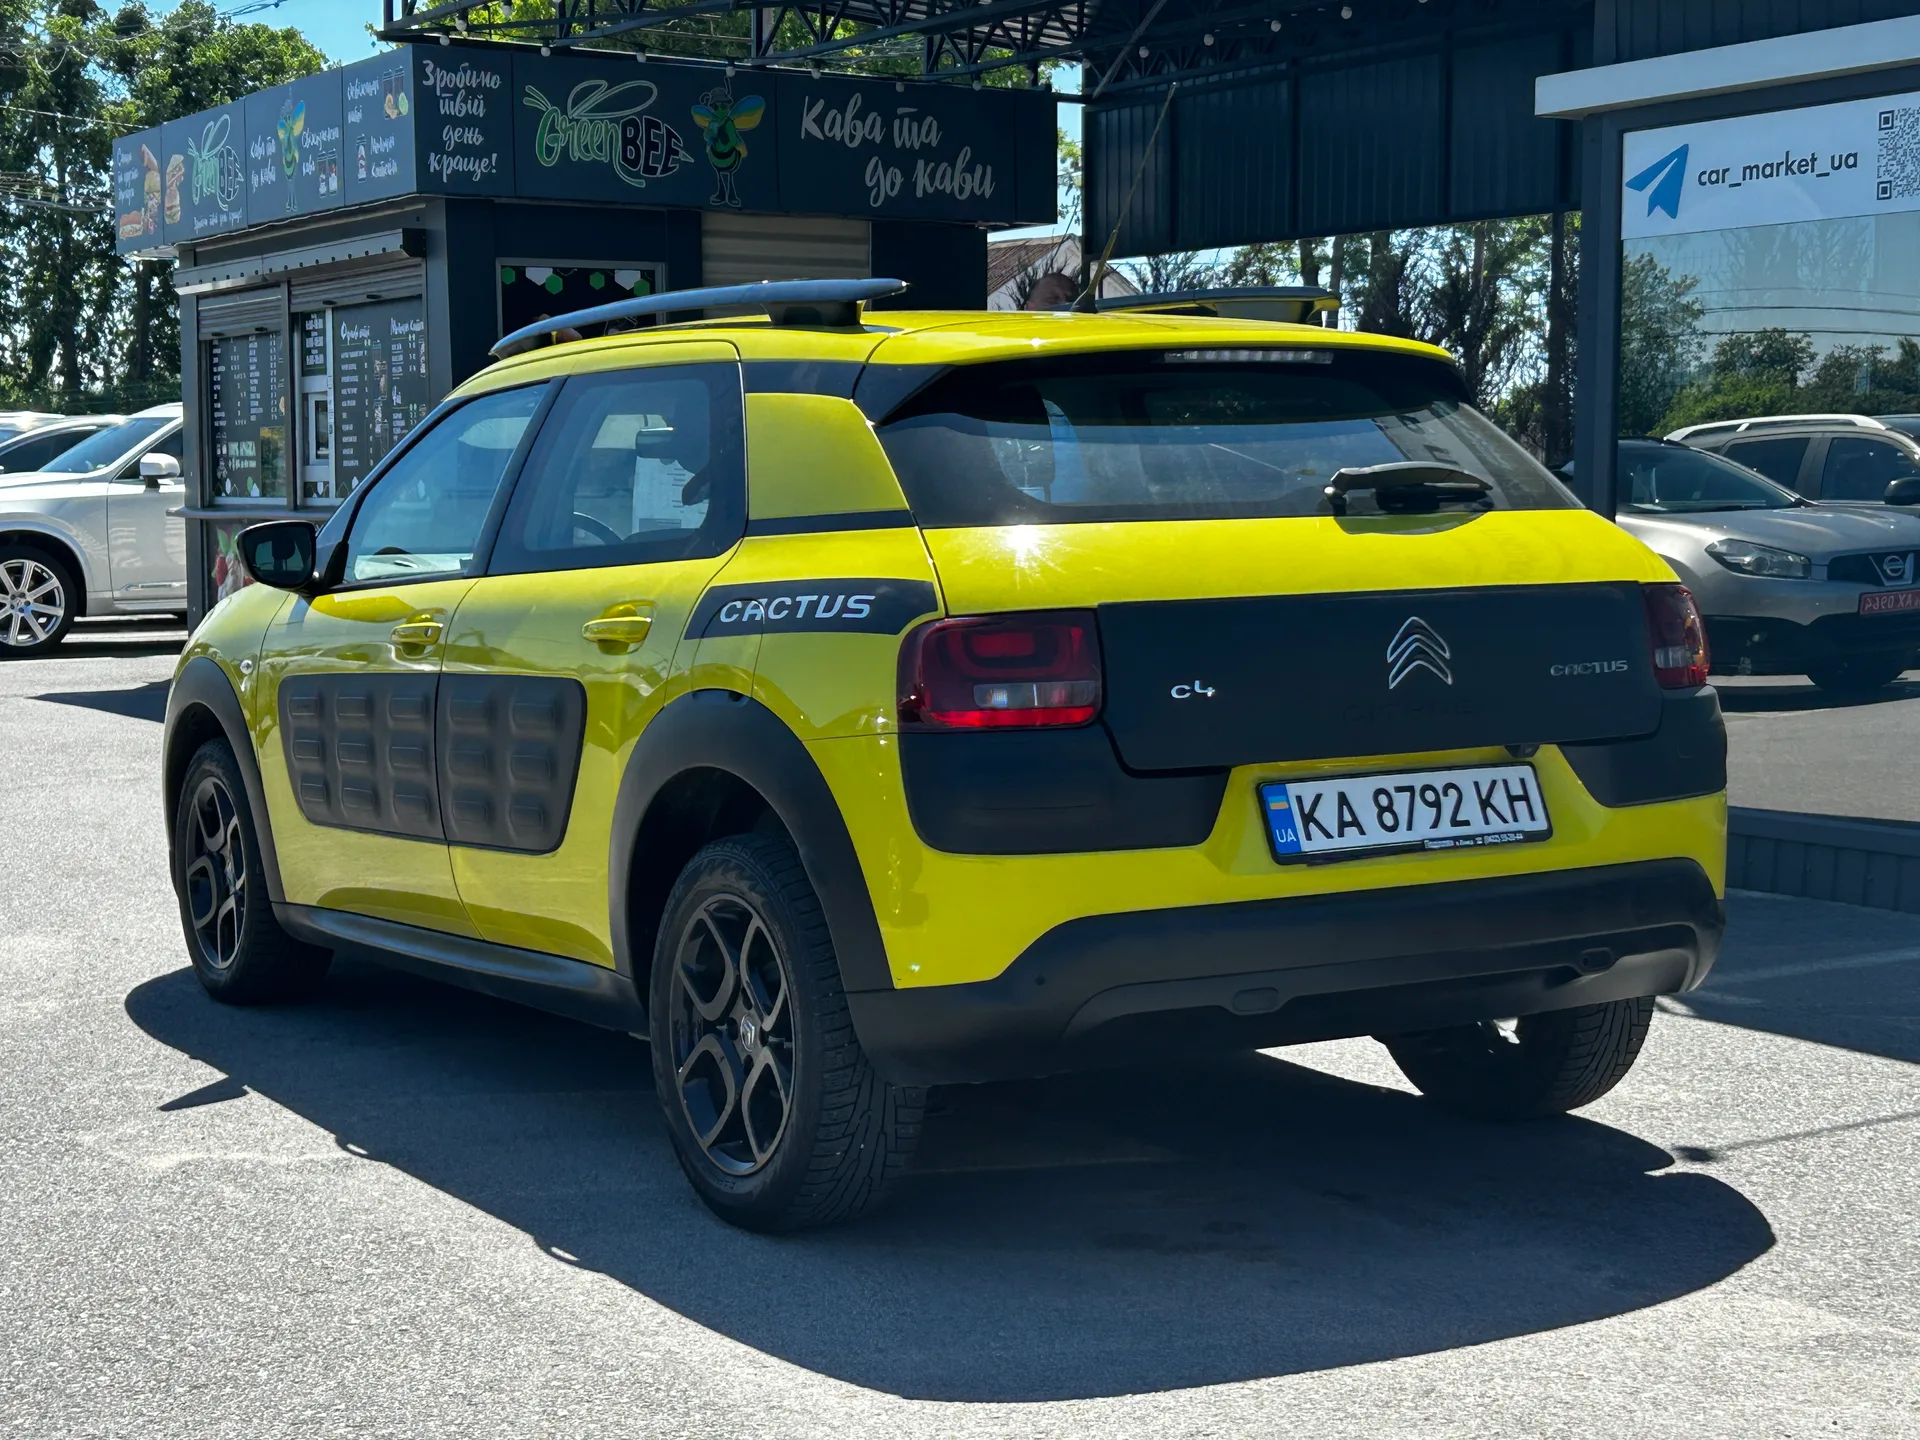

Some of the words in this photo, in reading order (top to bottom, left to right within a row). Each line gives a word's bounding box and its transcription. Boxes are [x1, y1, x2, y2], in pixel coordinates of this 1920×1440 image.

[422, 60, 501, 96] Зробимо
[439, 91, 486, 118] твій
[801, 93, 886, 148] Кава
[893, 107, 942, 150] та
[442, 124, 484, 151] день
[428, 152, 497, 183] краще!
[865, 155, 903, 208] до
[913, 146, 995, 200] кави
[1698, 151, 1858, 188] car_market_ua
[720, 595, 875, 623] CACTUS
[1550, 660, 1628, 676] CACTUS
[1295, 791, 1366, 841] KA
[1372, 782, 1471, 833] 8792
[1473, 777, 1537, 825] KH
[1276, 828, 1297, 844] UA
